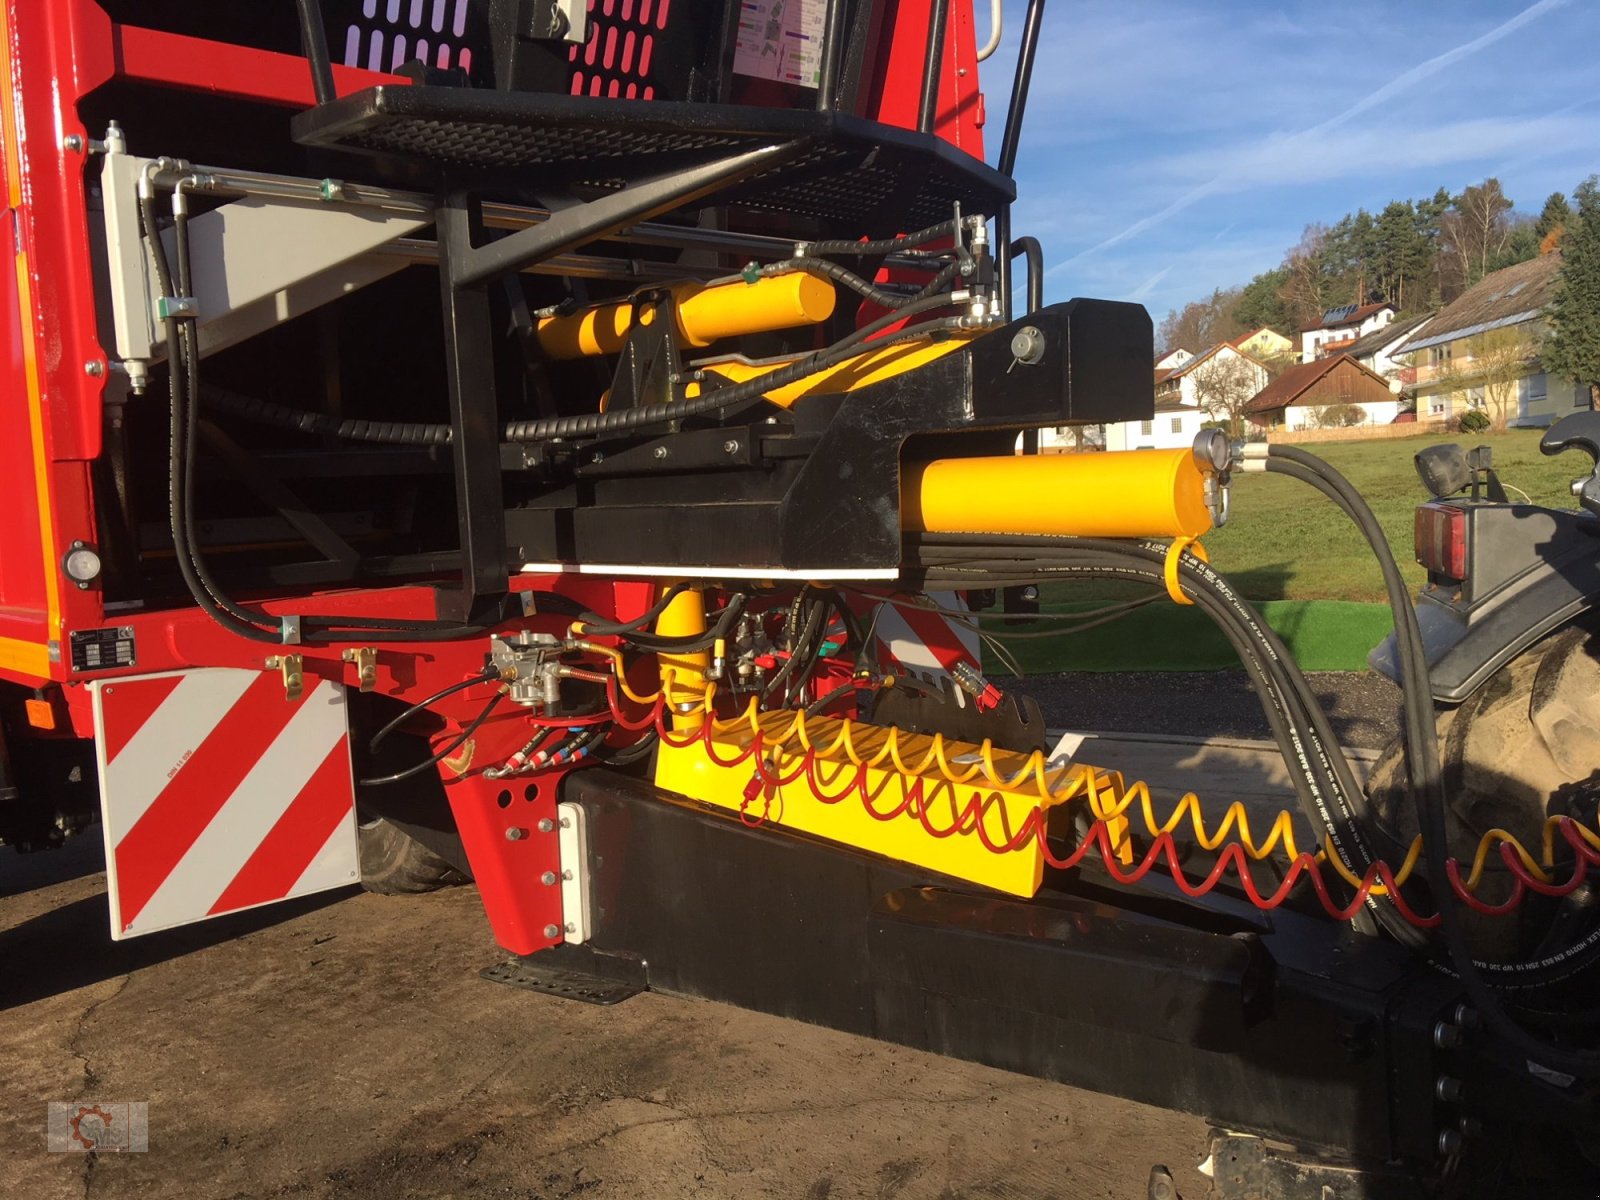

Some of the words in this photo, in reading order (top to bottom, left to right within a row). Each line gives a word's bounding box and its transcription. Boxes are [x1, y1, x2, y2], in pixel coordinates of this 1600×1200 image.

[1292, 735, 1304, 754] 2Q17
[1298, 753, 1309, 770] BAR
[166, 766, 178, 779] DIN
[1305, 770, 1315, 785] 330
[1310, 784, 1319, 796] WP
[1331, 782, 1340, 794] WP
[1315, 797, 1324, 807] 10
[1320, 806, 1330, 822] 2SN
[1565, 940, 1586, 956] HD210
[1554, 953, 1564, 962] EN
[1525, 962, 1539, 970] 2SN
